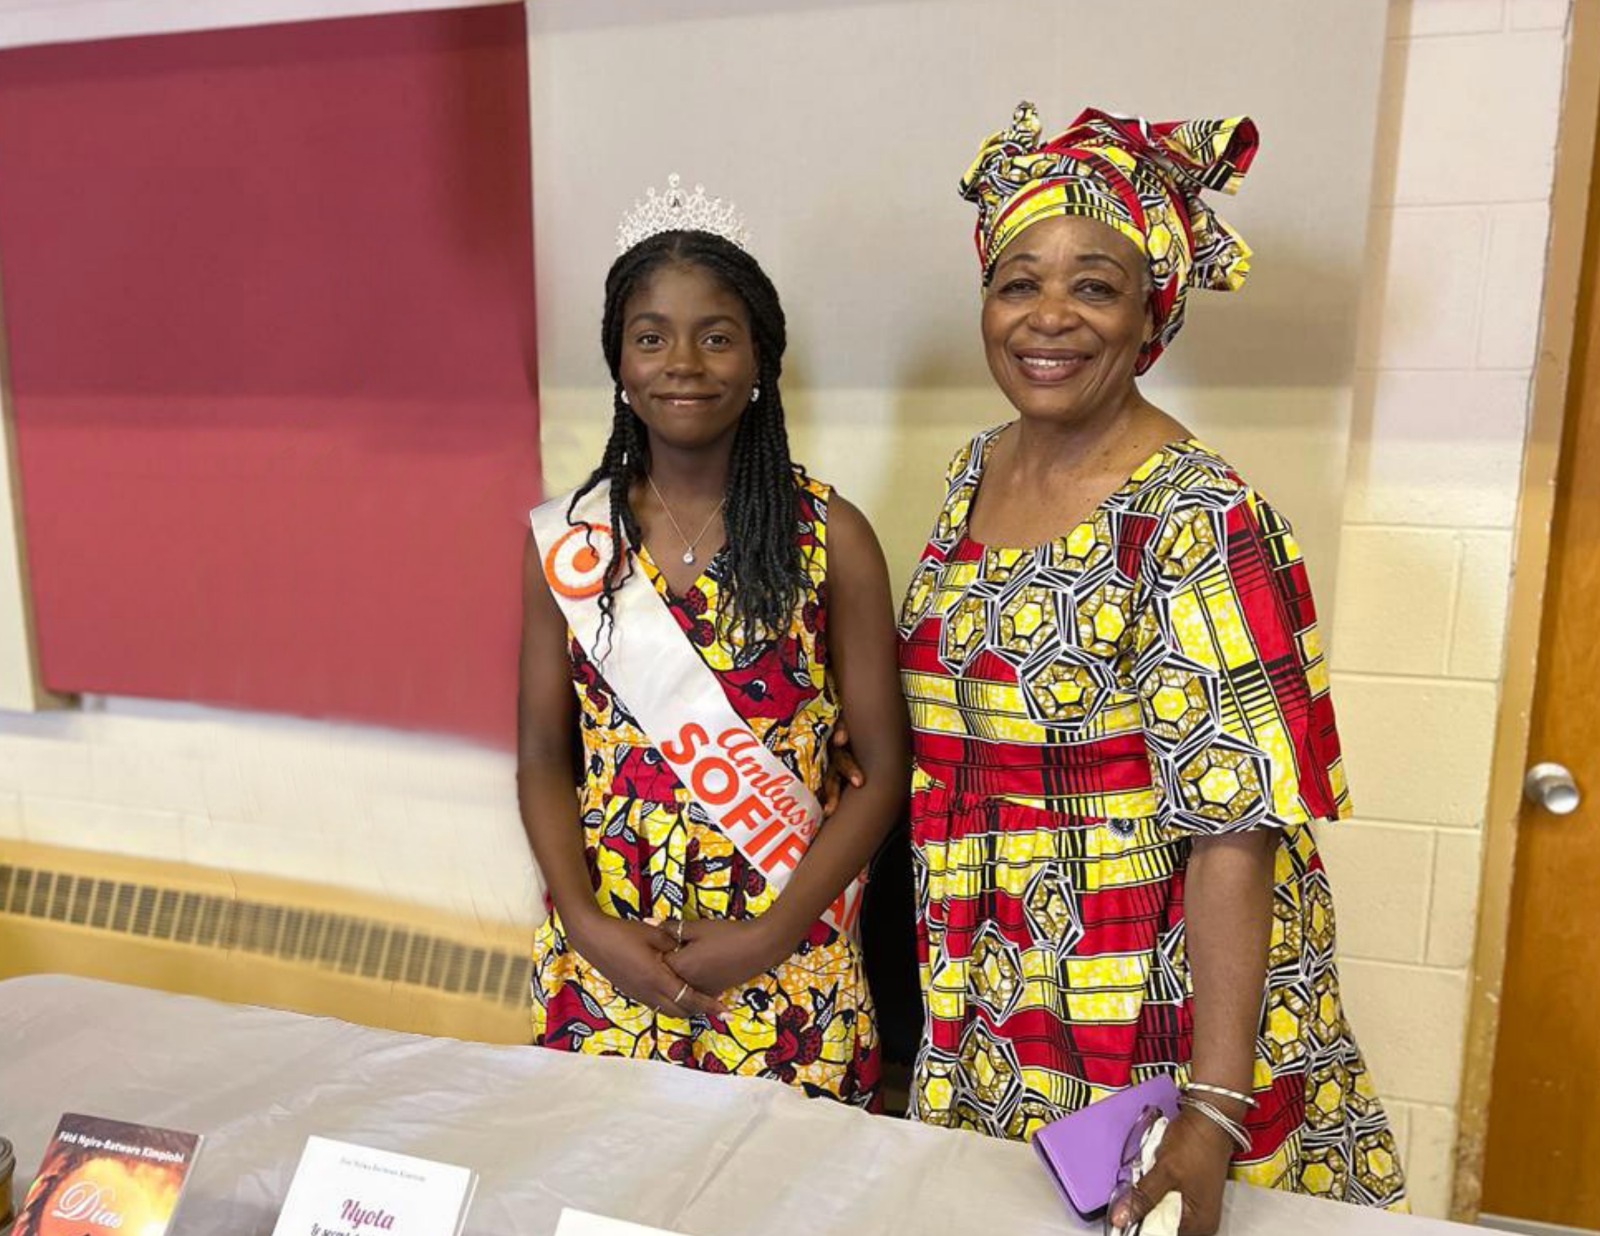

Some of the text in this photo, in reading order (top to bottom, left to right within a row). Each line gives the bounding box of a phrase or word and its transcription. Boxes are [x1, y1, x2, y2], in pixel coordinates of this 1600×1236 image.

[660, 722, 809, 873] SOFIF
[716, 727, 817, 837] Ambass
[340, 1198, 395, 1230] Nyola
